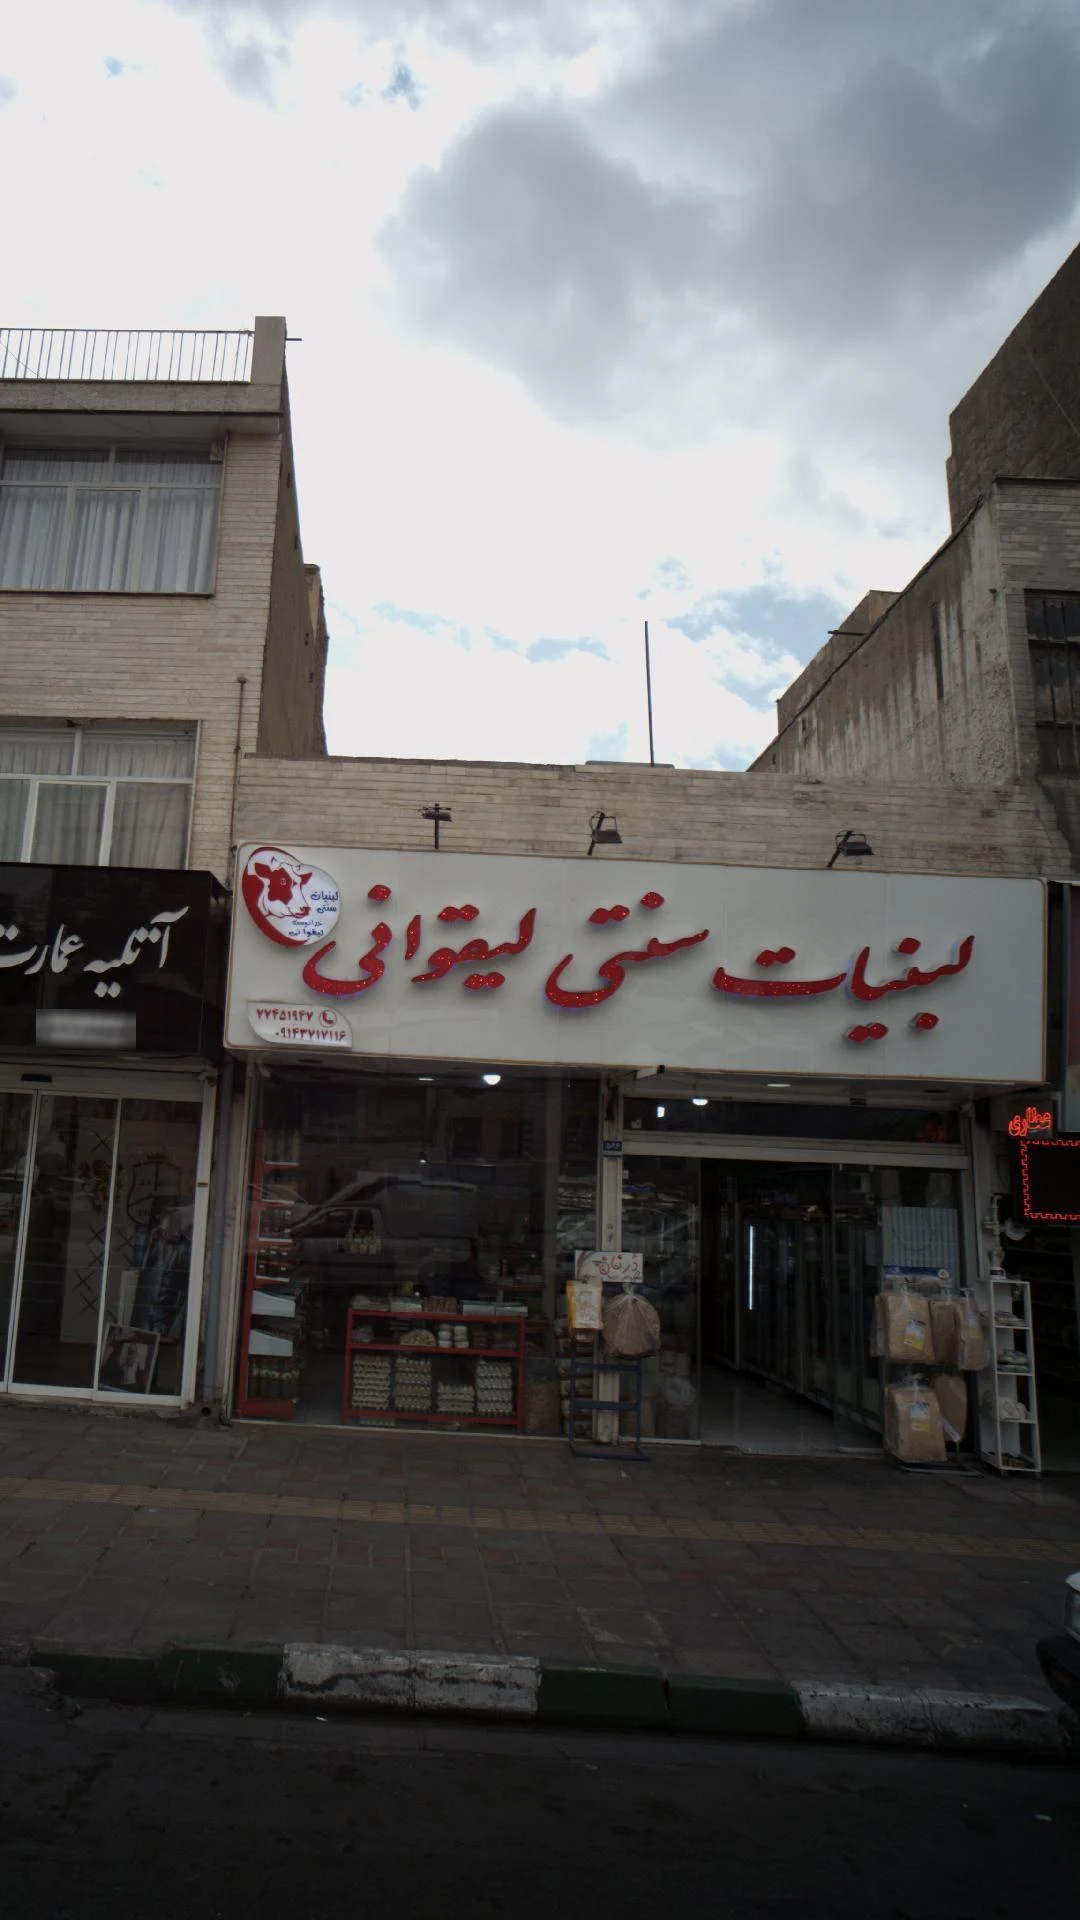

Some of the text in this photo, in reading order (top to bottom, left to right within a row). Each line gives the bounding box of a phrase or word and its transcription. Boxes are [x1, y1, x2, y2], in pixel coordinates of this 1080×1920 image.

[310, 889, 340, 903] لبنیات
[316, 904, 337, 914] سنتی
[82, 905, 190, 999] آتلیه
[302, 883, 975, 1043] لبنیات سنتی لیقوانی
[1008, 1106, 1052, 1137] عطاری
